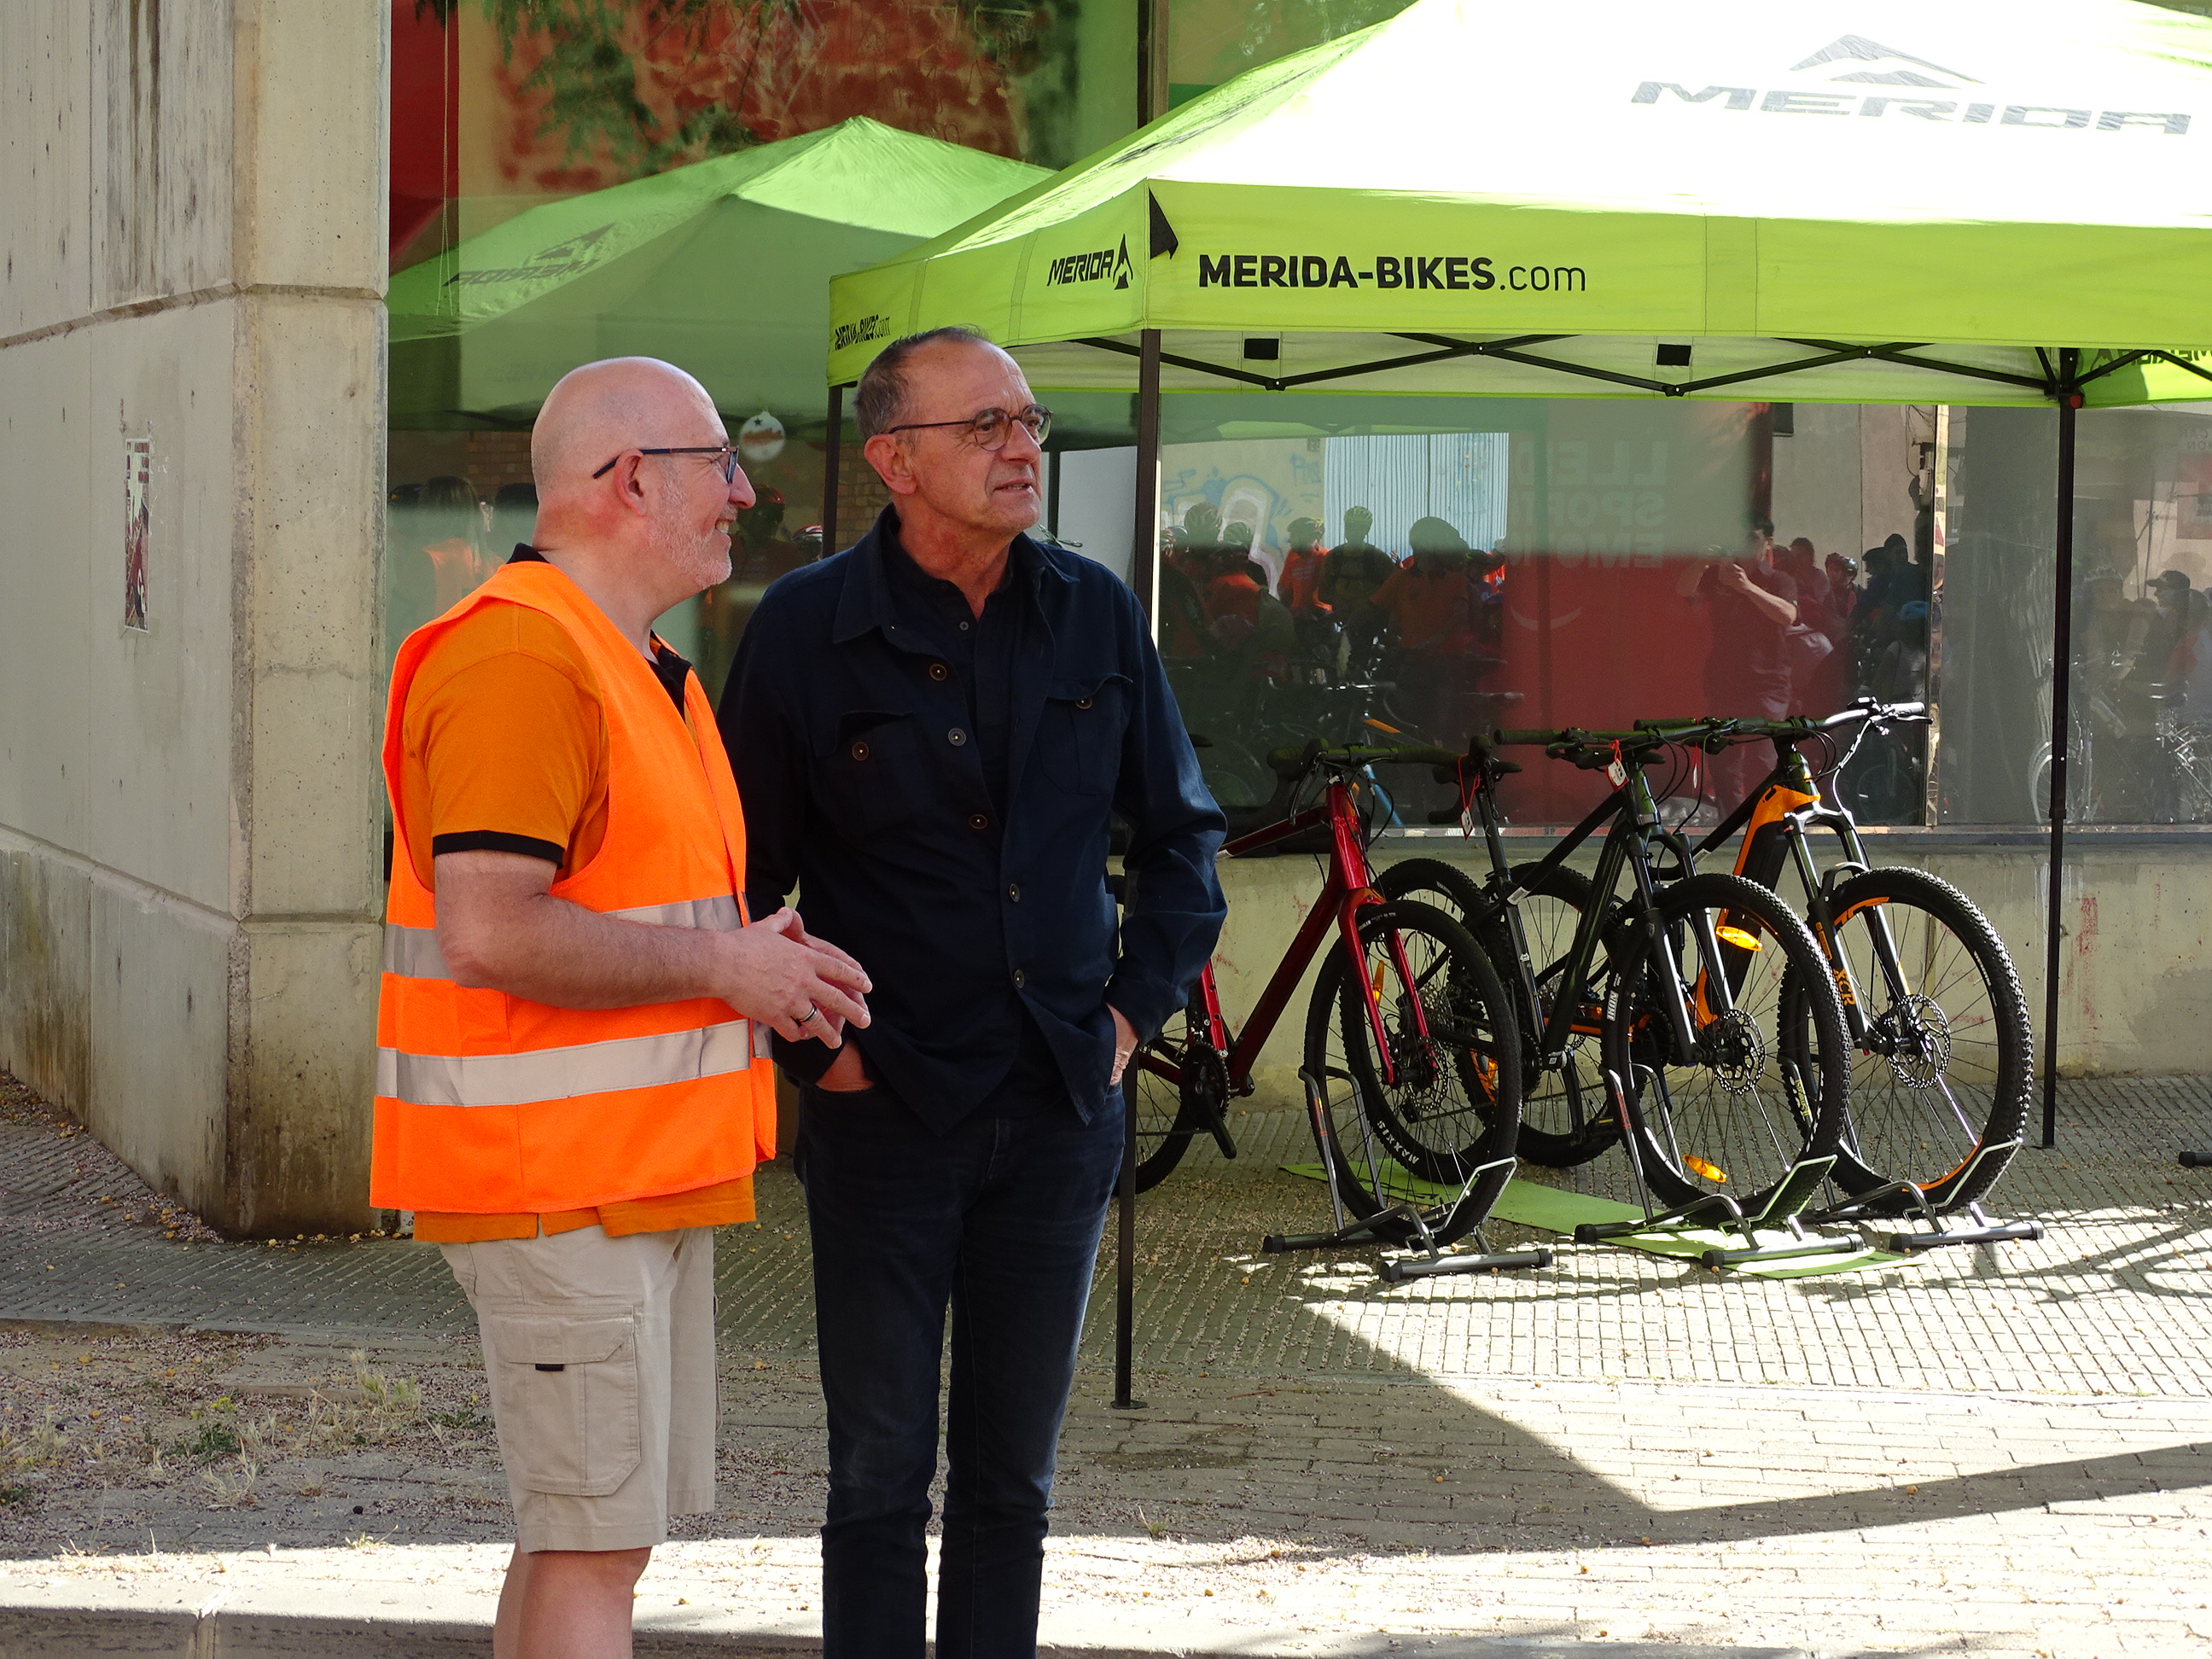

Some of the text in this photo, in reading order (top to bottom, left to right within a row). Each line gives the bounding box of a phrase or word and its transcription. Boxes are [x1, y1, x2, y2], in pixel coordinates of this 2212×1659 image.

[1630, 80, 2192, 135] MERIDA
[1047, 248, 1114, 286] MERIDA
[1198, 253, 1586, 292] MERIDA-BIKES.com
[1832, 968, 1856, 1006] XCR
[1377, 1120, 1420, 1165] MAXXIS
